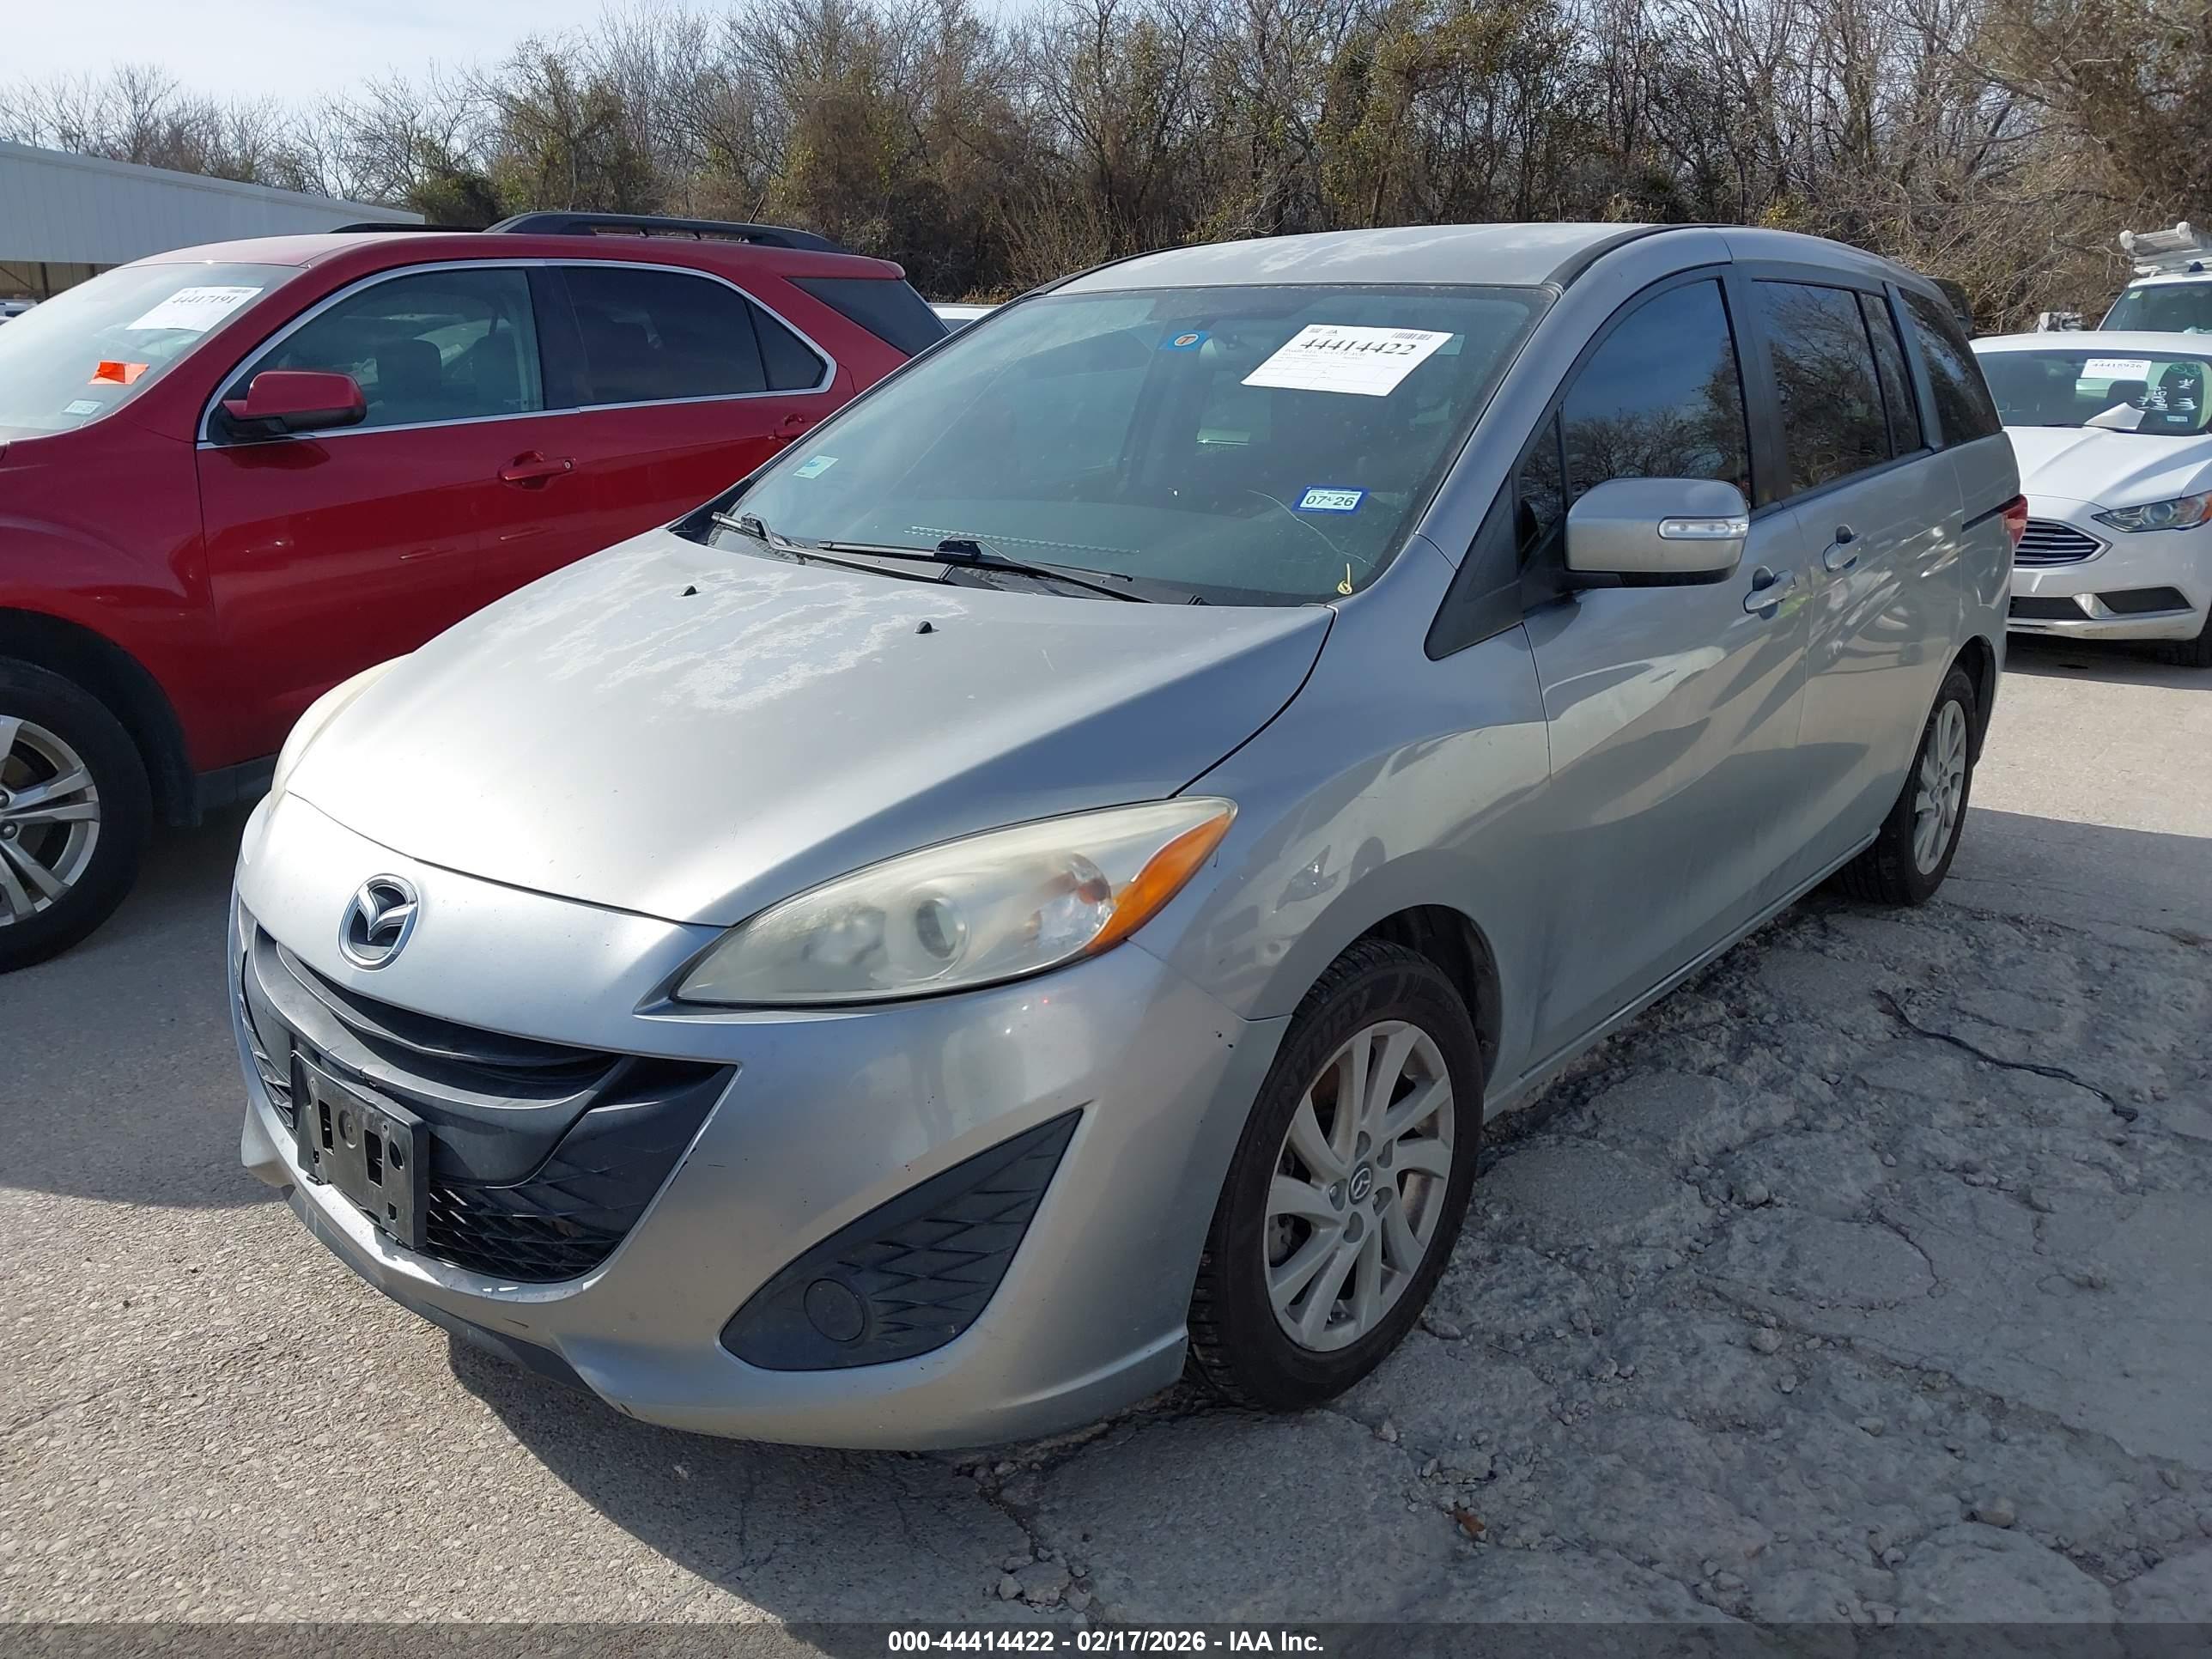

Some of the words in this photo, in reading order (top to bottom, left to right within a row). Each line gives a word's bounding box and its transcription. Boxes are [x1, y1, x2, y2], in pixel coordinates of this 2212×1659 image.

[1299, 338, 1418, 356] 44414422
[1305, 495, 1328, 505] 07
[1333, 496, 1355, 507] 26
